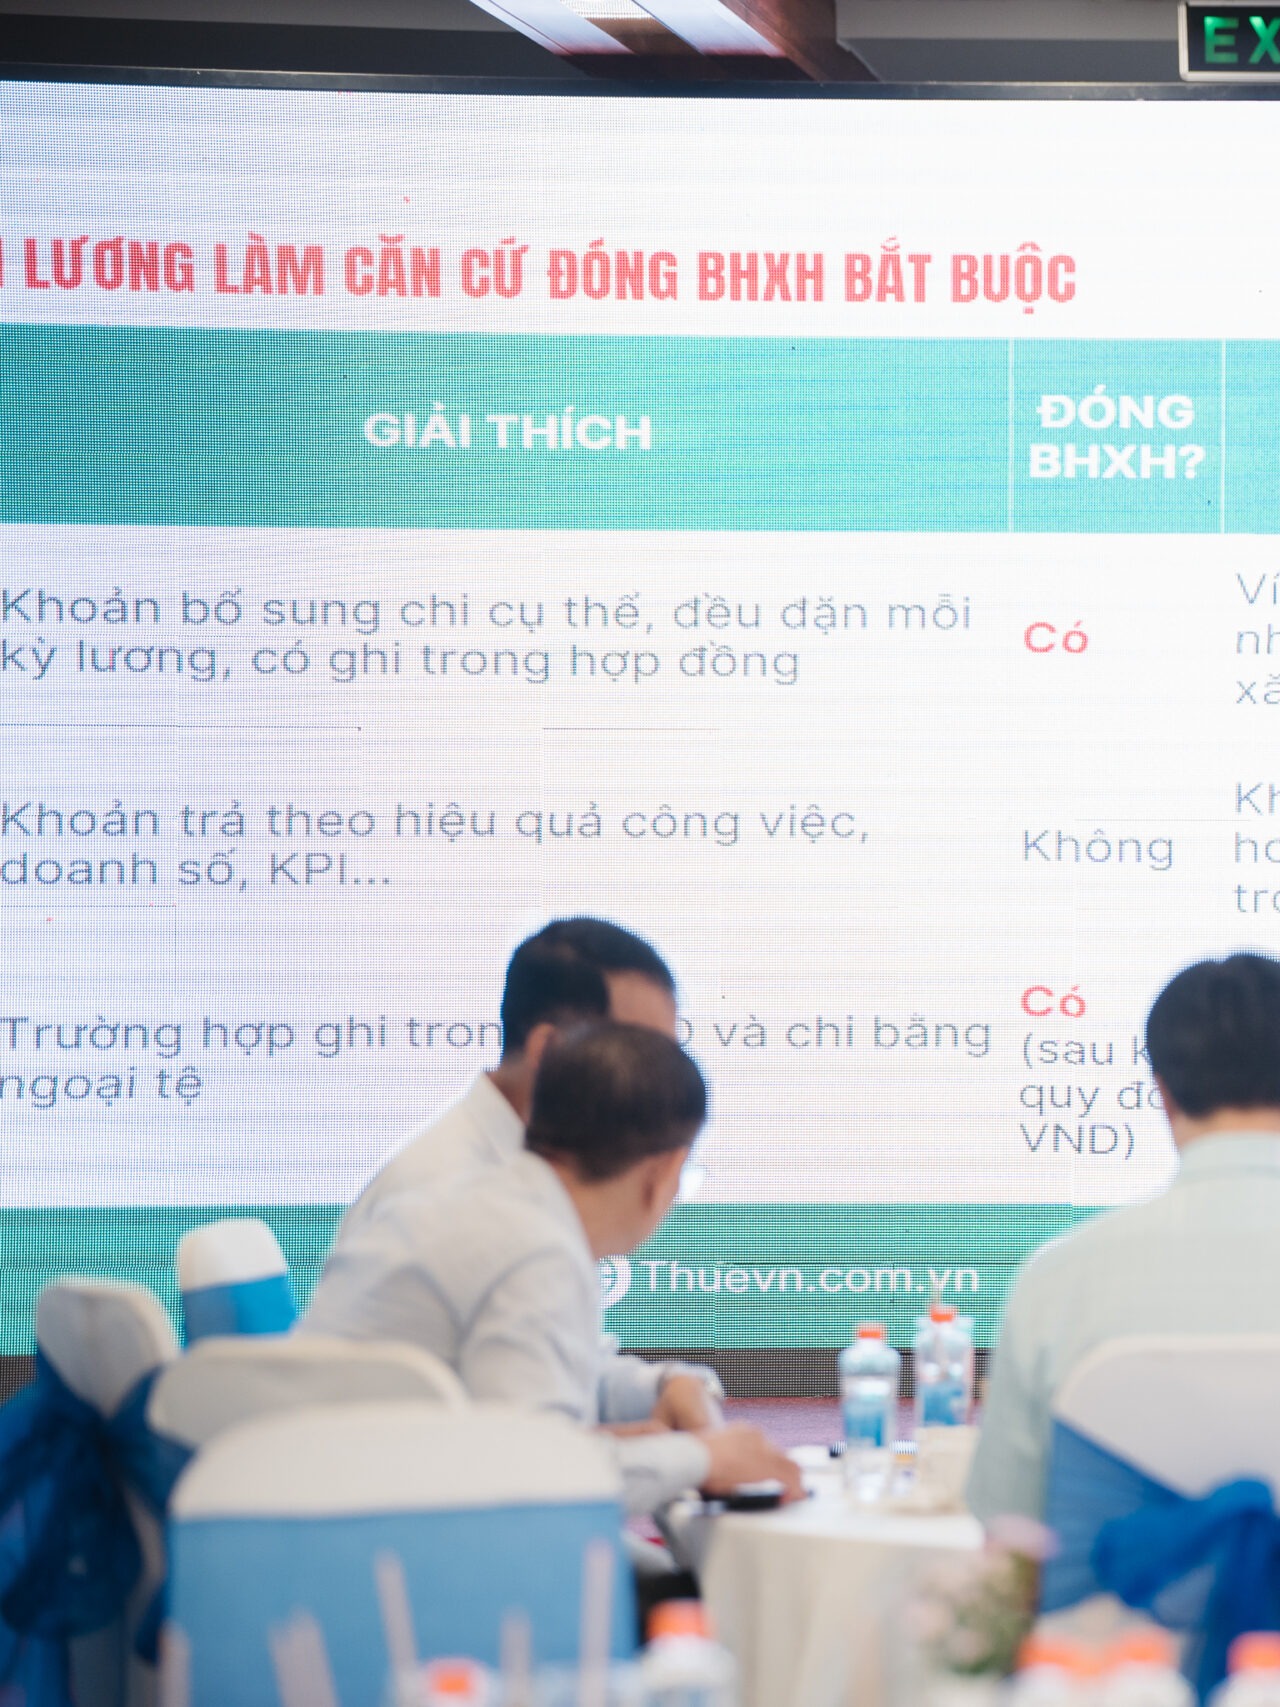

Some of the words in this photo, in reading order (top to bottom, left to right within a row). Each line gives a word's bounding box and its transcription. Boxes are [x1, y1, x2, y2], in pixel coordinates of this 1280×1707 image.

[24, 235, 194, 292] LƯƠNG
[214, 232, 324, 295] LÀM
[344, 234, 441, 297] CĂN
[461, 237, 529, 299] CỨ
[546, 238, 678, 300] ĐÓNG
[698, 251, 824, 302] BHXH
[844, 237, 932, 303] BẮT
[951, 242, 1076, 314] BUỘC
[363, 401, 472, 449] GIẢI
[486, 405, 655, 451] THÍCH
[1036, 384, 1195, 430] ĐÓNG
[1029, 443, 1207, 479] BHXH?
[2, 586, 160, 624] Khoản
[262, 599, 380, 636] sung
[399, 593, 469, 627] chi
[488, 601, 544, 634] cụ
[673, 592, 761, 630] đều
[1236, 572, 1280, 606] Ví
[1024, 621, 1089, 654] Có
[78, 639, 231, 682] lương,
[251, 639, 311, 674] có
[329, 641, 401, 683] ghi
[421, 644, 551, 684] trong
[570, 643, 661, 684] hợp
[678, 641, 799, 686] đồng
[2, 800, 159, 837] Khoản
[181, 800, 245, 837] trả
[266, 803, 375, 837] theo
[395, 802, 496, 843] hiệu
[515, 801, 602, 845] quả
[621, 804, 740, 847] công
[759, 804, 868, 844] việc,
[0, 852, 158, 885] doanh
[178, 848, 248, 892] số,
[1023, 828, 1174, 872] Không
[1020, 985, 1086, 1018] Có
[0, 1015, 183, 1059] Trường
[203, 1016, 295, 1057] hợp
[314, 1015, 387, 1059] ghi
[406, 1015, 504, 1051] tron
[713, 1014, 767, 1049] và
[785, 1015, 854, 1049] chi
[1023, 1032, 1114, 1069] (sau
[0, 1066, 137, 1110] ngoại
[156, 1065, 204, 1106] tệ
[1019, 1084, 1100, 1119] quy
[1020, 1123, 1135, 1160] VND)
